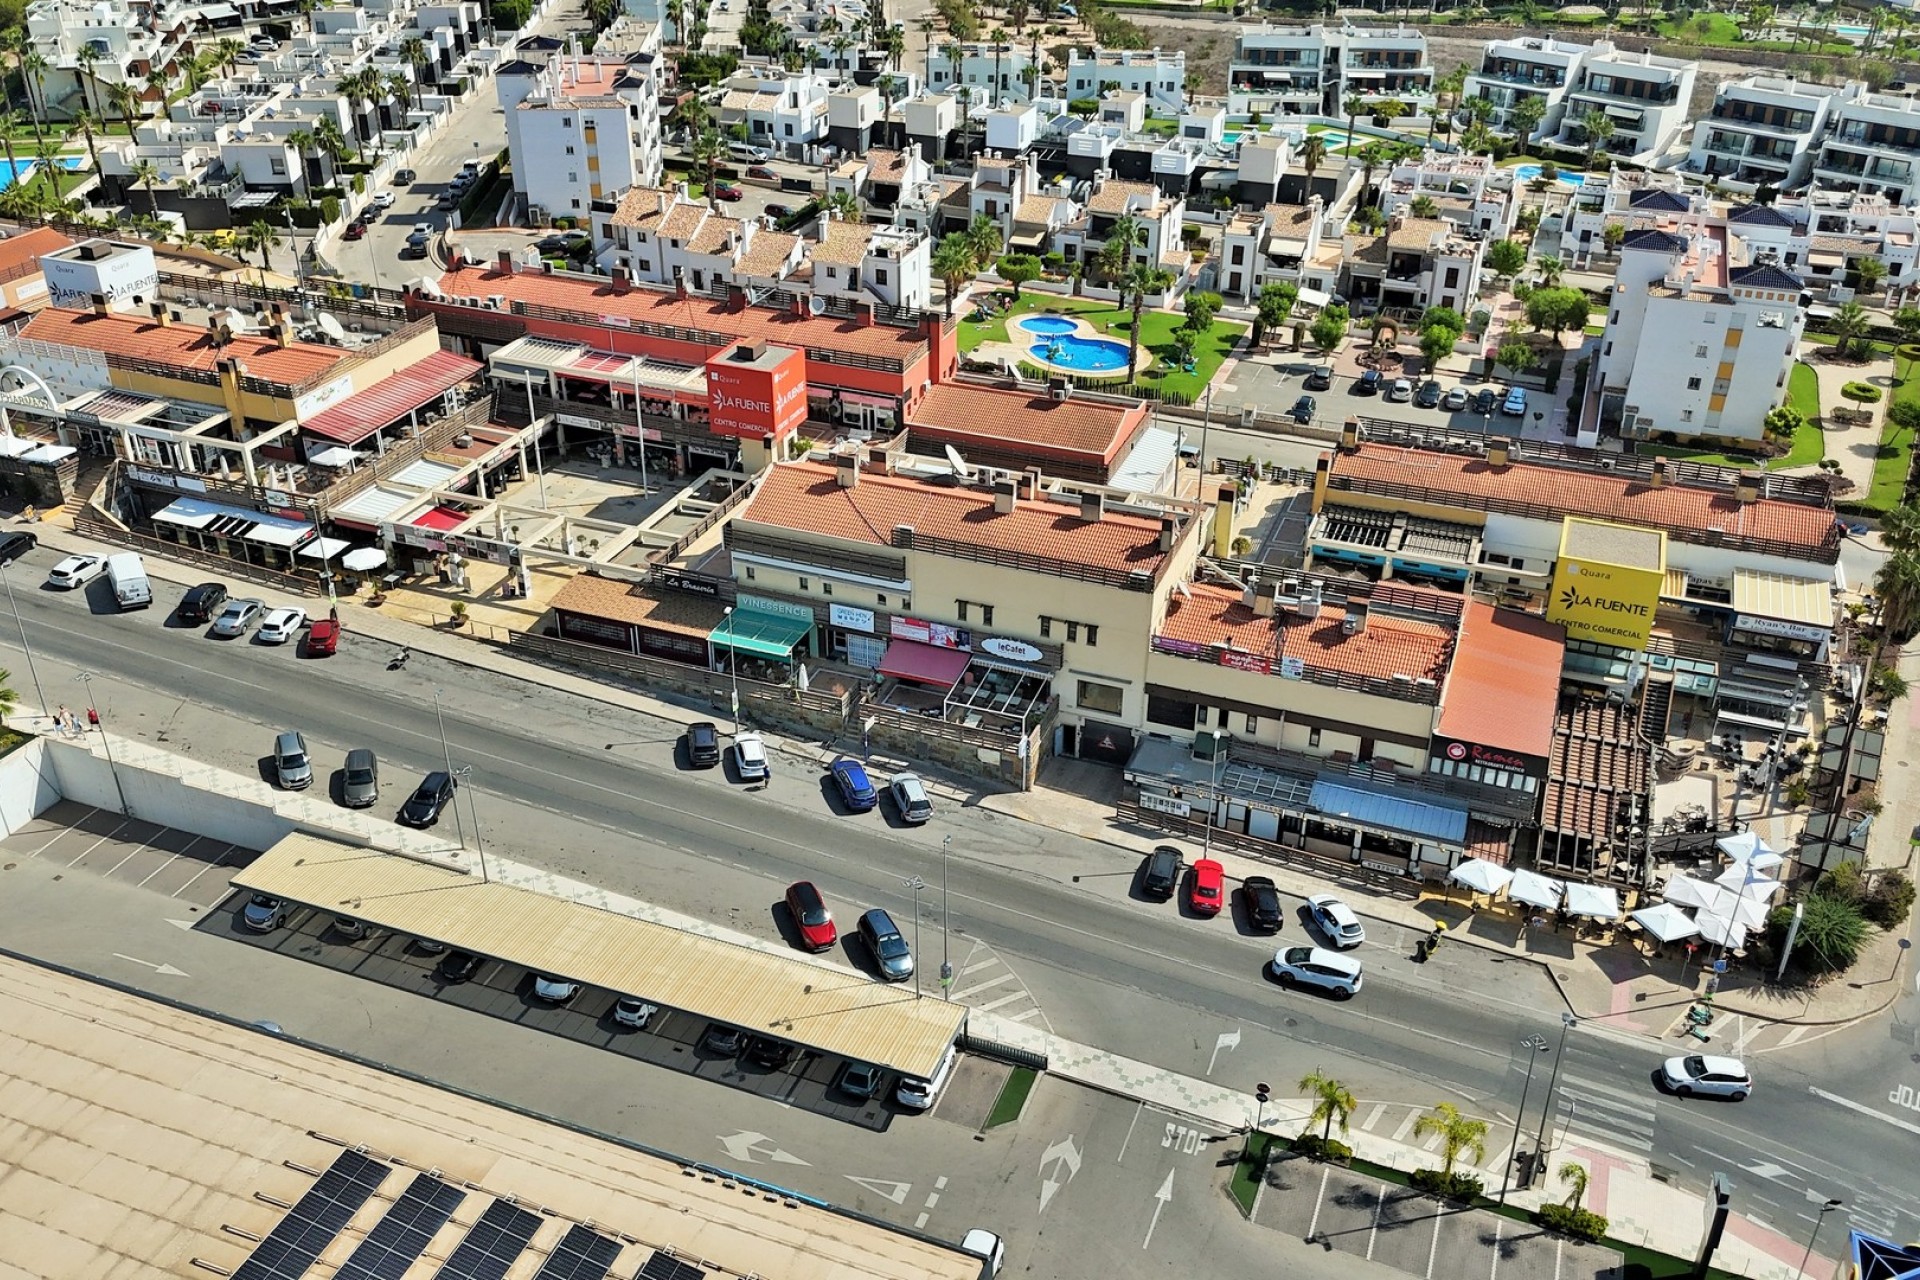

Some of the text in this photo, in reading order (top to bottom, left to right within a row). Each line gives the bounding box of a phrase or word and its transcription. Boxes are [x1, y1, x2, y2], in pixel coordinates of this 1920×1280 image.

[116, 273, 159, 297] LA FUENTE
[719, 375, 740, 385] Quara
[722, 396, 771, 413] LA FUENTE
[713, 417, 770, 433] CENTRO COMERCIAL
[1580, 568, 1611, 580] Quara
[742, 597, 808, 617] VINESSENCE
[1575, 594, 1650, 617] LA FUENTE
[1554, 618, 1643, 640] CENTRO COMERCIAL
[1788, 624, 1808, 633] Bar
[1160, 1122, 1210, 1157] STOP
